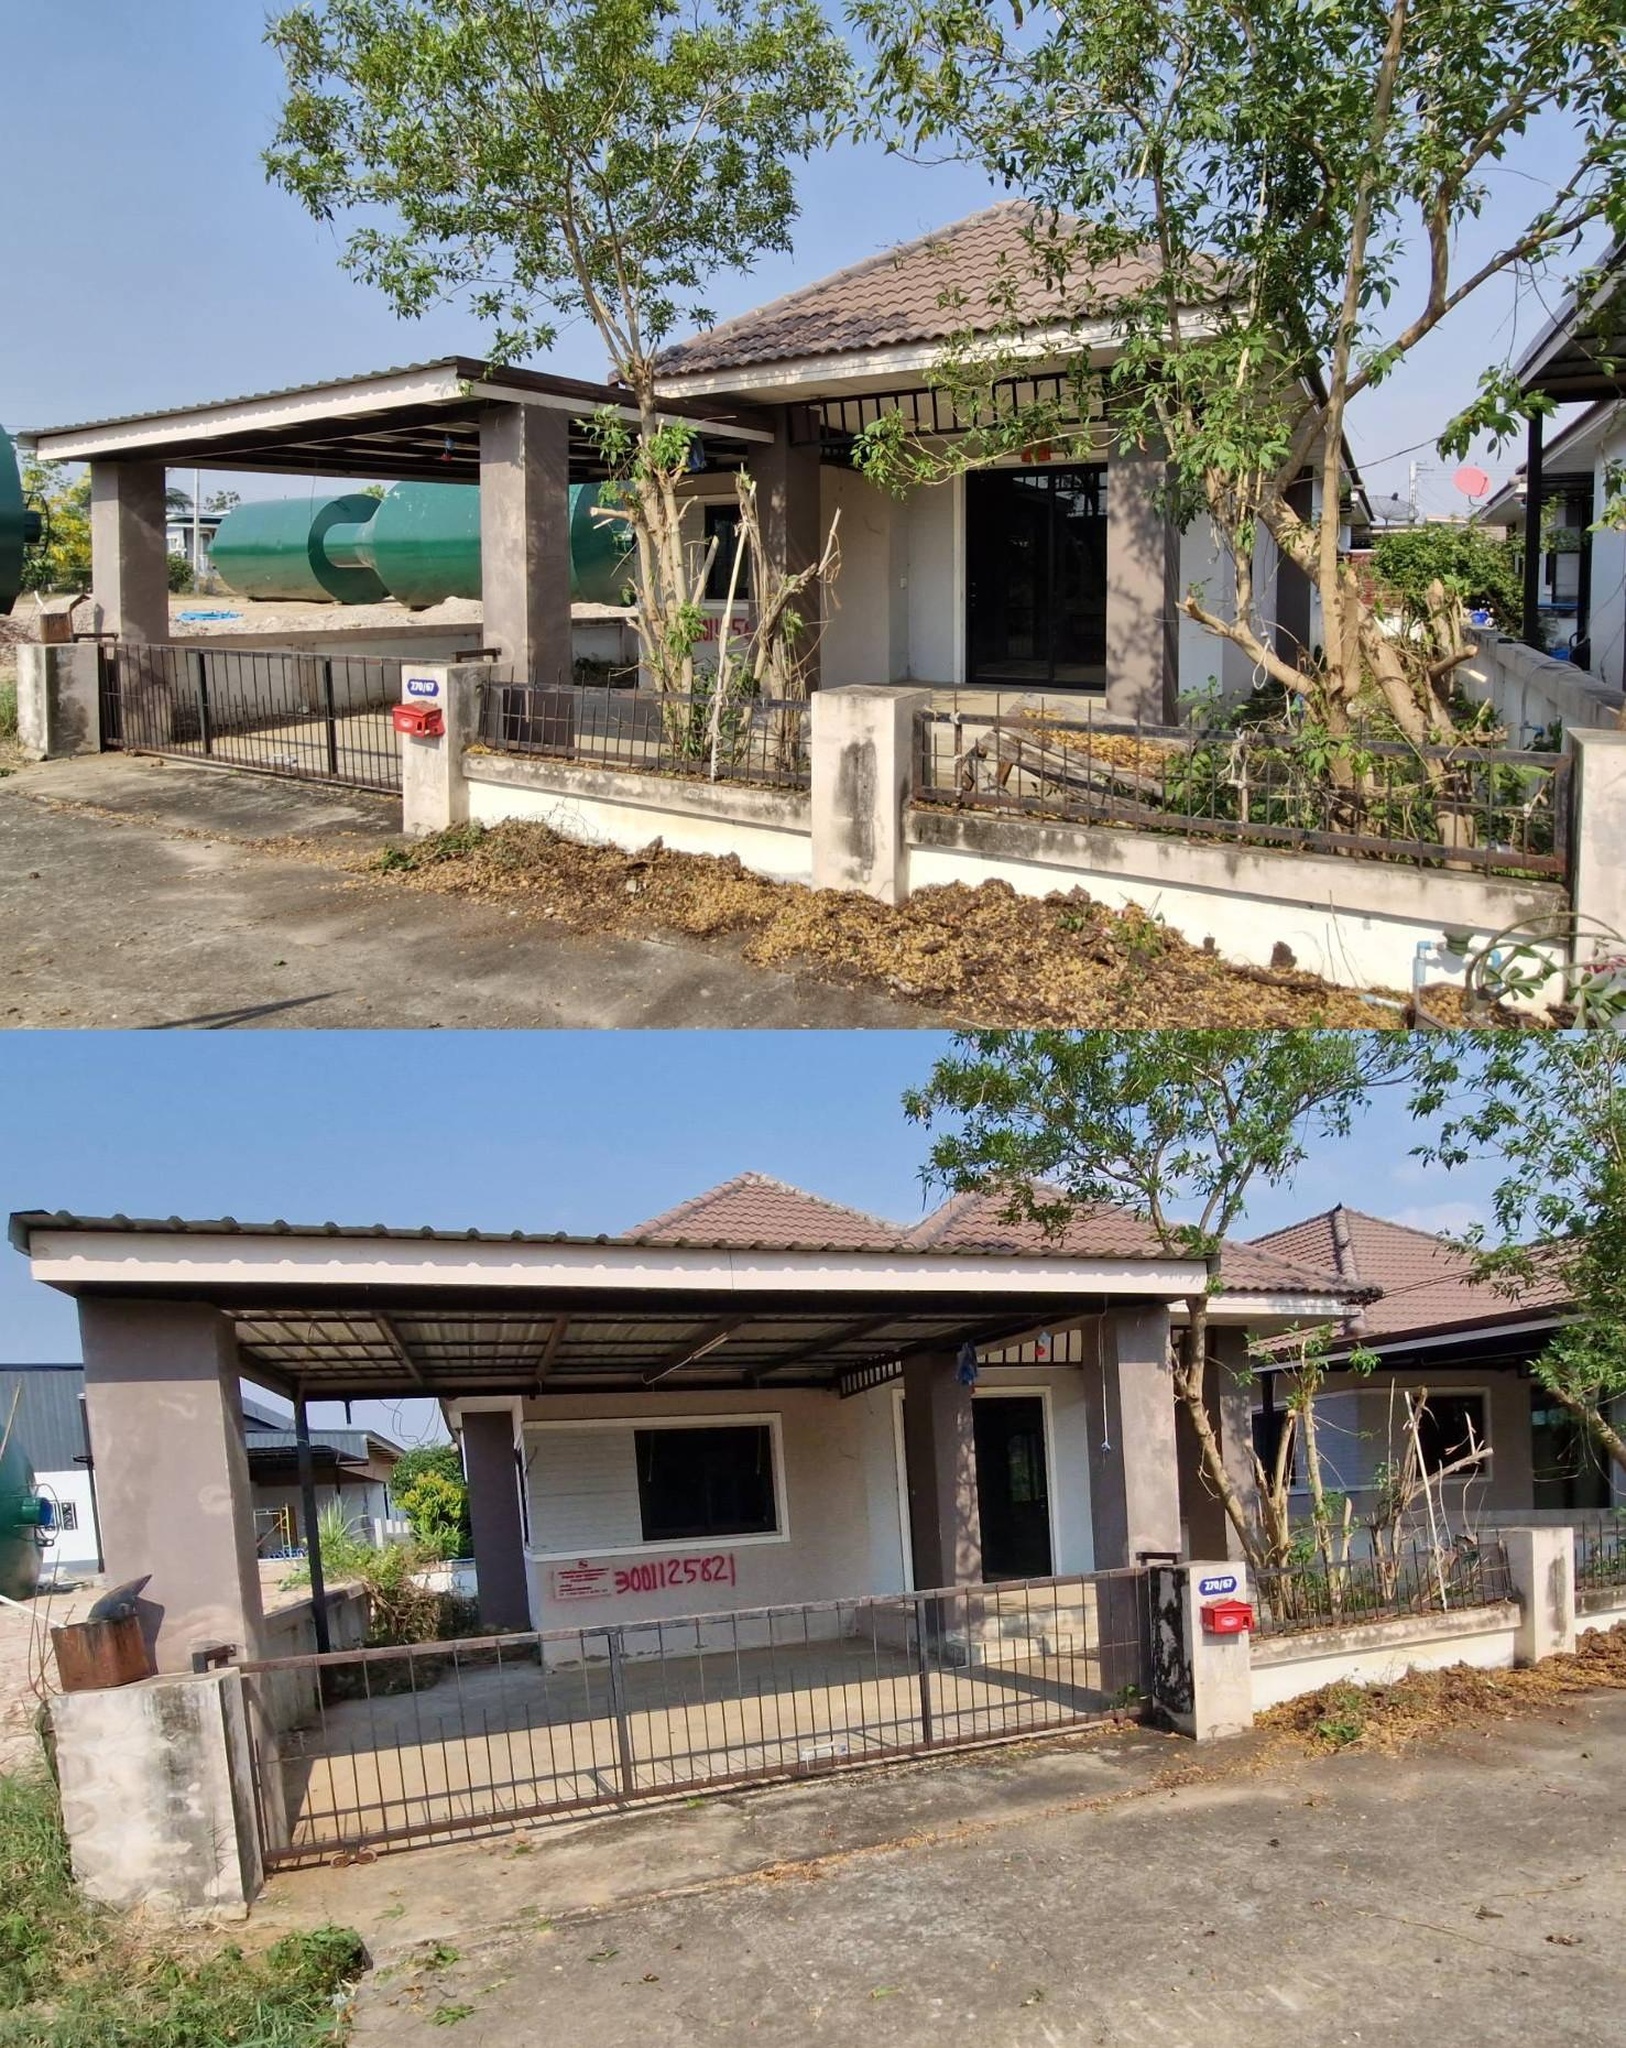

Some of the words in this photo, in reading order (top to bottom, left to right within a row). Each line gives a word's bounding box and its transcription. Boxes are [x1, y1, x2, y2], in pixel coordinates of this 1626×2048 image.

[410, 681, 434, 692] 270/67
[614, 1553, 736, 1594] 3001125821
[1205, 1578, 1233, 1591] 270/67
